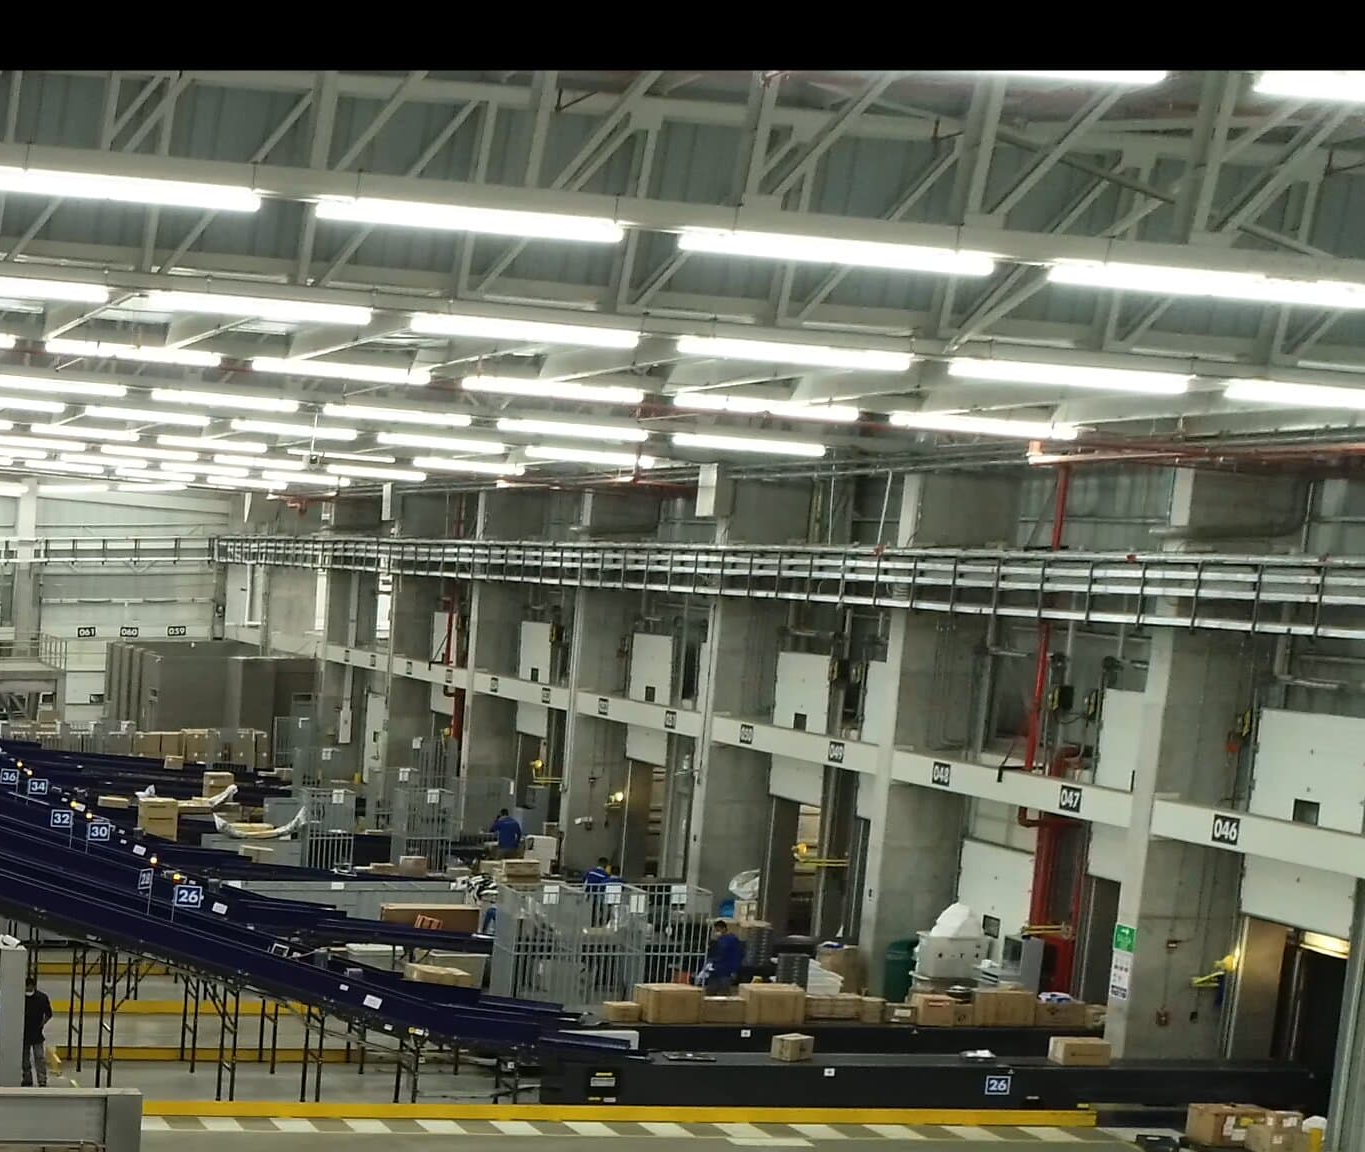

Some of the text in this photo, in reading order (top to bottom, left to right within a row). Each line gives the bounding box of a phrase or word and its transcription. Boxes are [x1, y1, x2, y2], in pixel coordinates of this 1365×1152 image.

[78, 628, 95, 637] 061
[169, 626, 185, 635] 059
[2, 771, 16, 782] 36
[933, 764, 950, 783] 048
[31, 781, 46, 791] 34
[1060, 788, 1080, 808] 047
[53, 813, 70, 824] 32
[90, 826, 107, 837] 30
[1213, 819, 1238, 841] 046
[179, 890, 199, 903] 26
[989, 1079, 1007, 1091] 26
